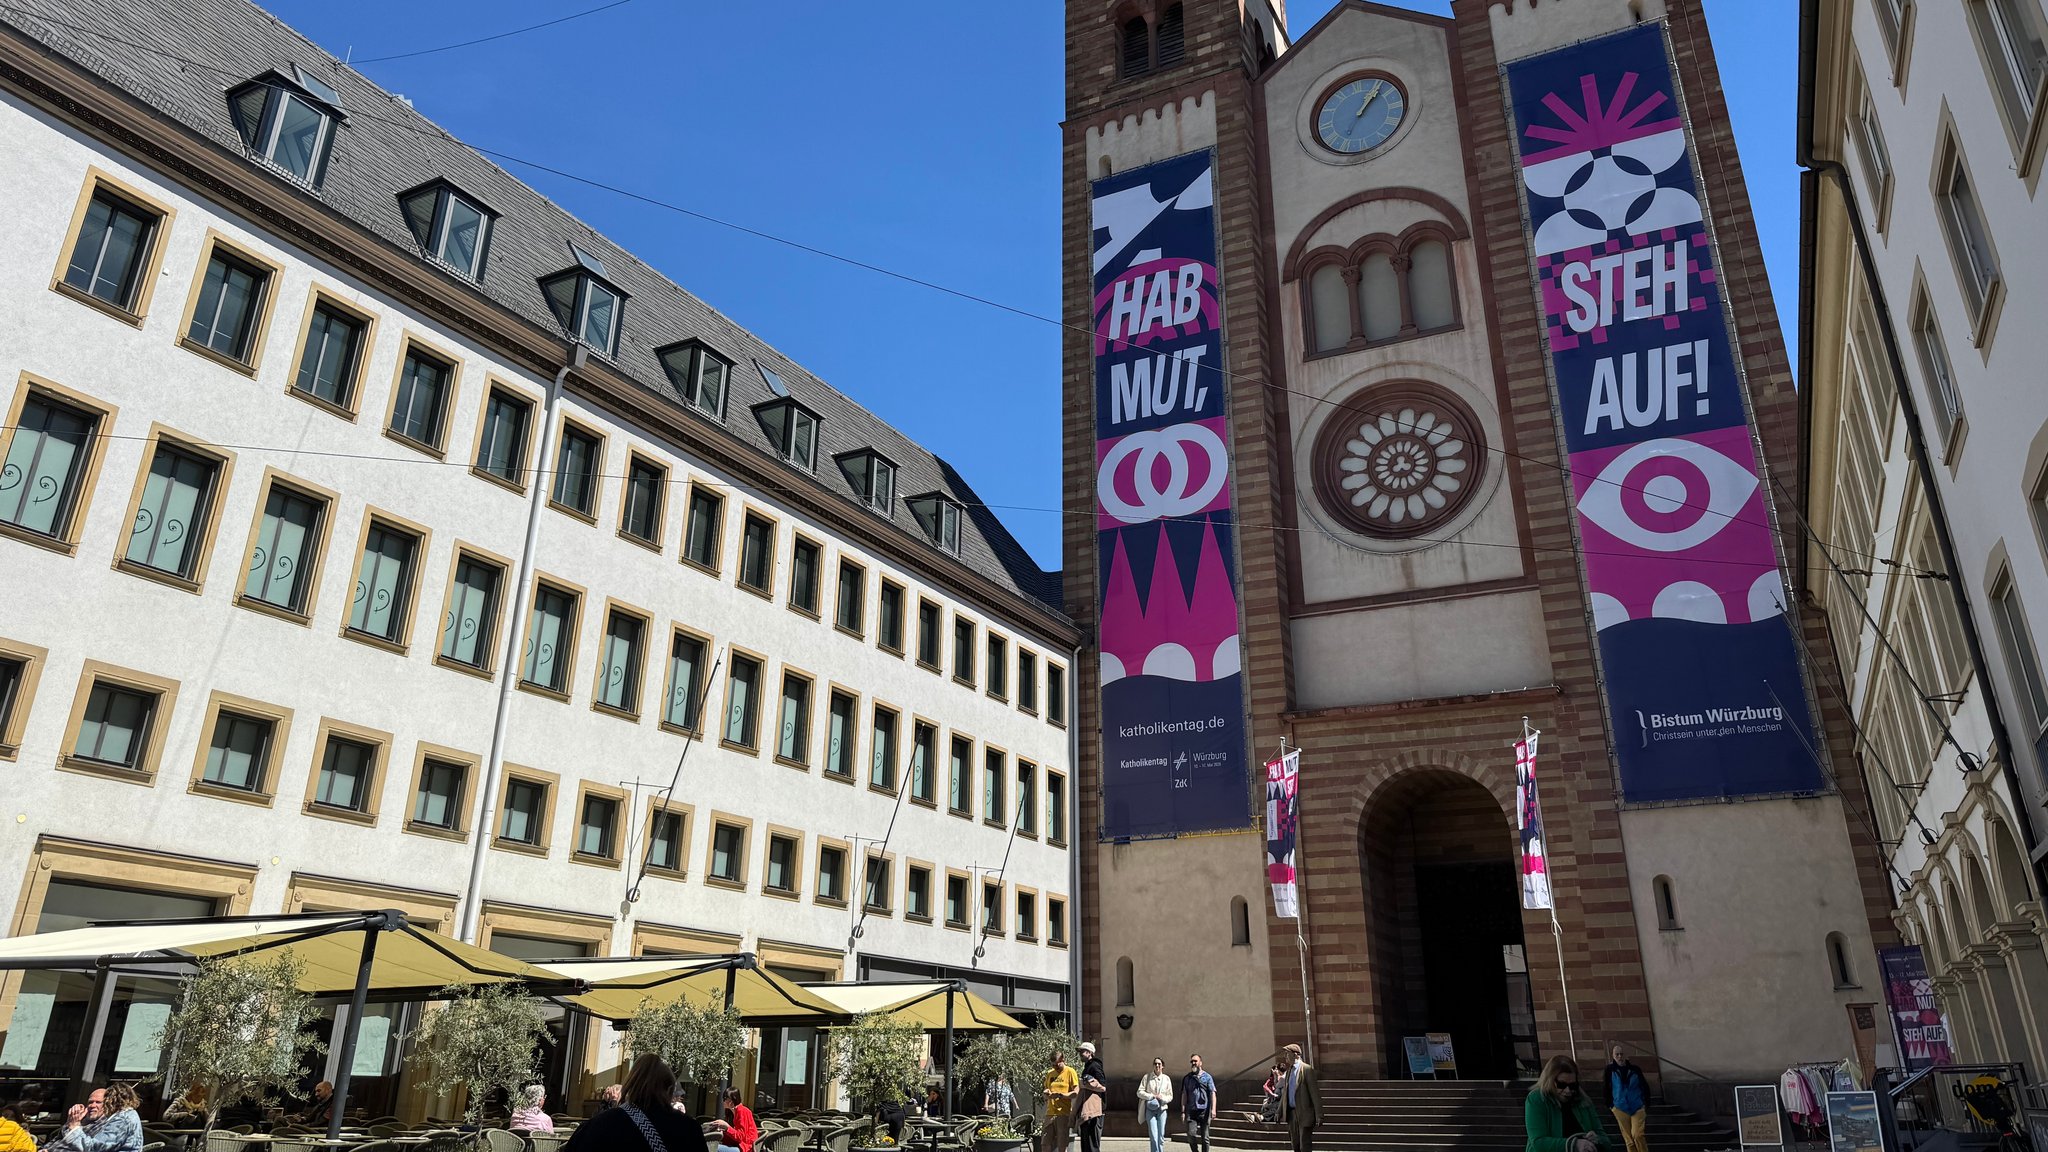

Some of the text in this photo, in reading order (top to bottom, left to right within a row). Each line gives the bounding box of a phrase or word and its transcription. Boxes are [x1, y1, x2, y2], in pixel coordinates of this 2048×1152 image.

[1561, 239, 1689, 333] STEH
[1109, 263, 1203, 341] HAB
[1111, 344, 1208, 425] MUT,
[1584, 339, 1710, 435] AUF!
[1120, 716, 1225, 738] katholikentag.de
[1650, 706, 1783, 728] Bistum Würzburg
[1653, 723, 1782, 741] Christsein unter den Menschen
[1120, 757, 1168, 769] Katholikentag
[1193, 752, 1227, 762] Würzburg
[1902, 1027, 1923, 1042] STEH
